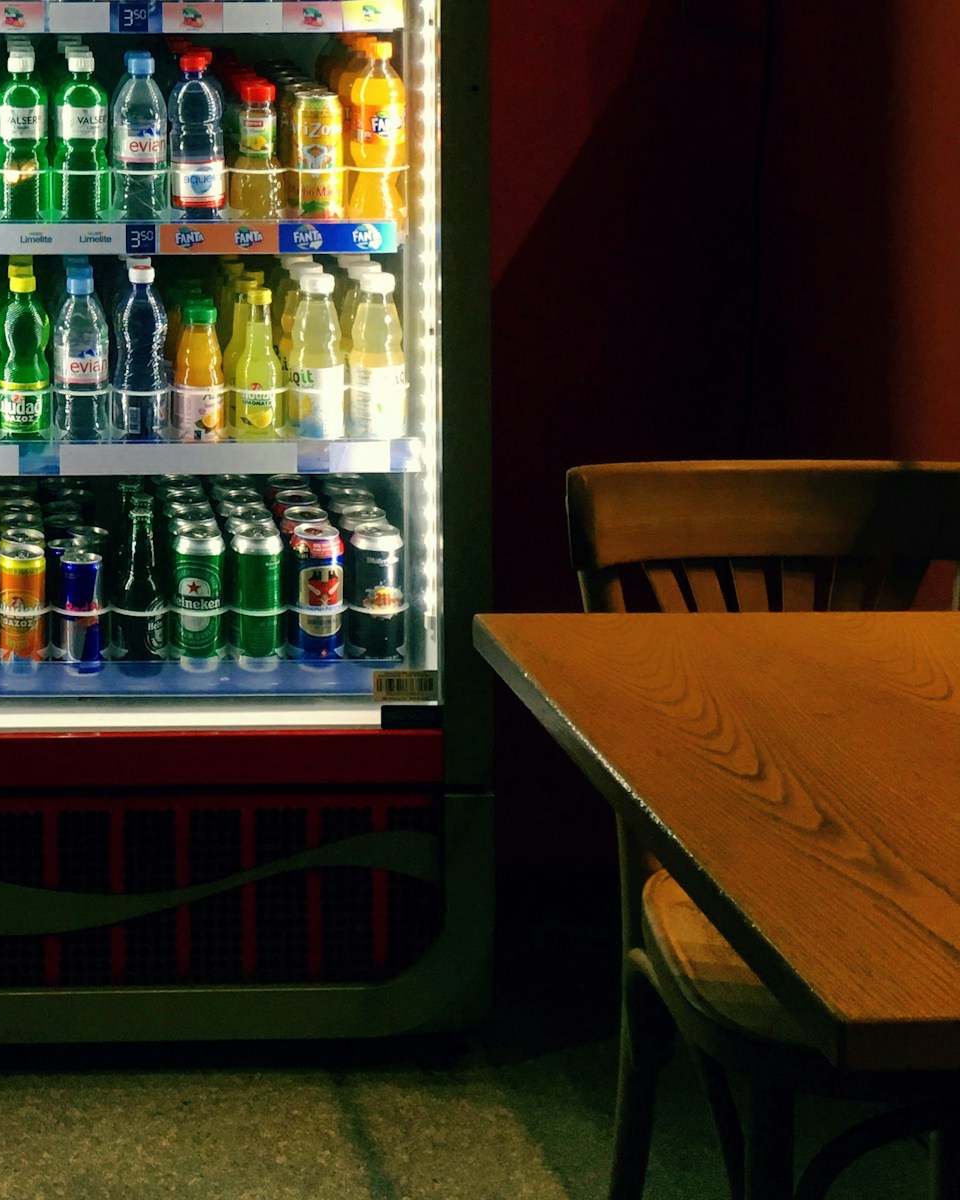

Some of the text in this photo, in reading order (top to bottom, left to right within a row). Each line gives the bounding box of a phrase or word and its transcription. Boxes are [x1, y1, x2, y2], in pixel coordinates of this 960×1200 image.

[129, 139, 166, 153] evian
[20, 236, 52, 244] Limelite
[79, 236, 112, 244] Limelite
[175, 231, 204, 245] FANTA
[234, 231, 263, 245] FANTA
[293, 230, 323, 244] FANTA
[70, 359, 108, 373] evian
